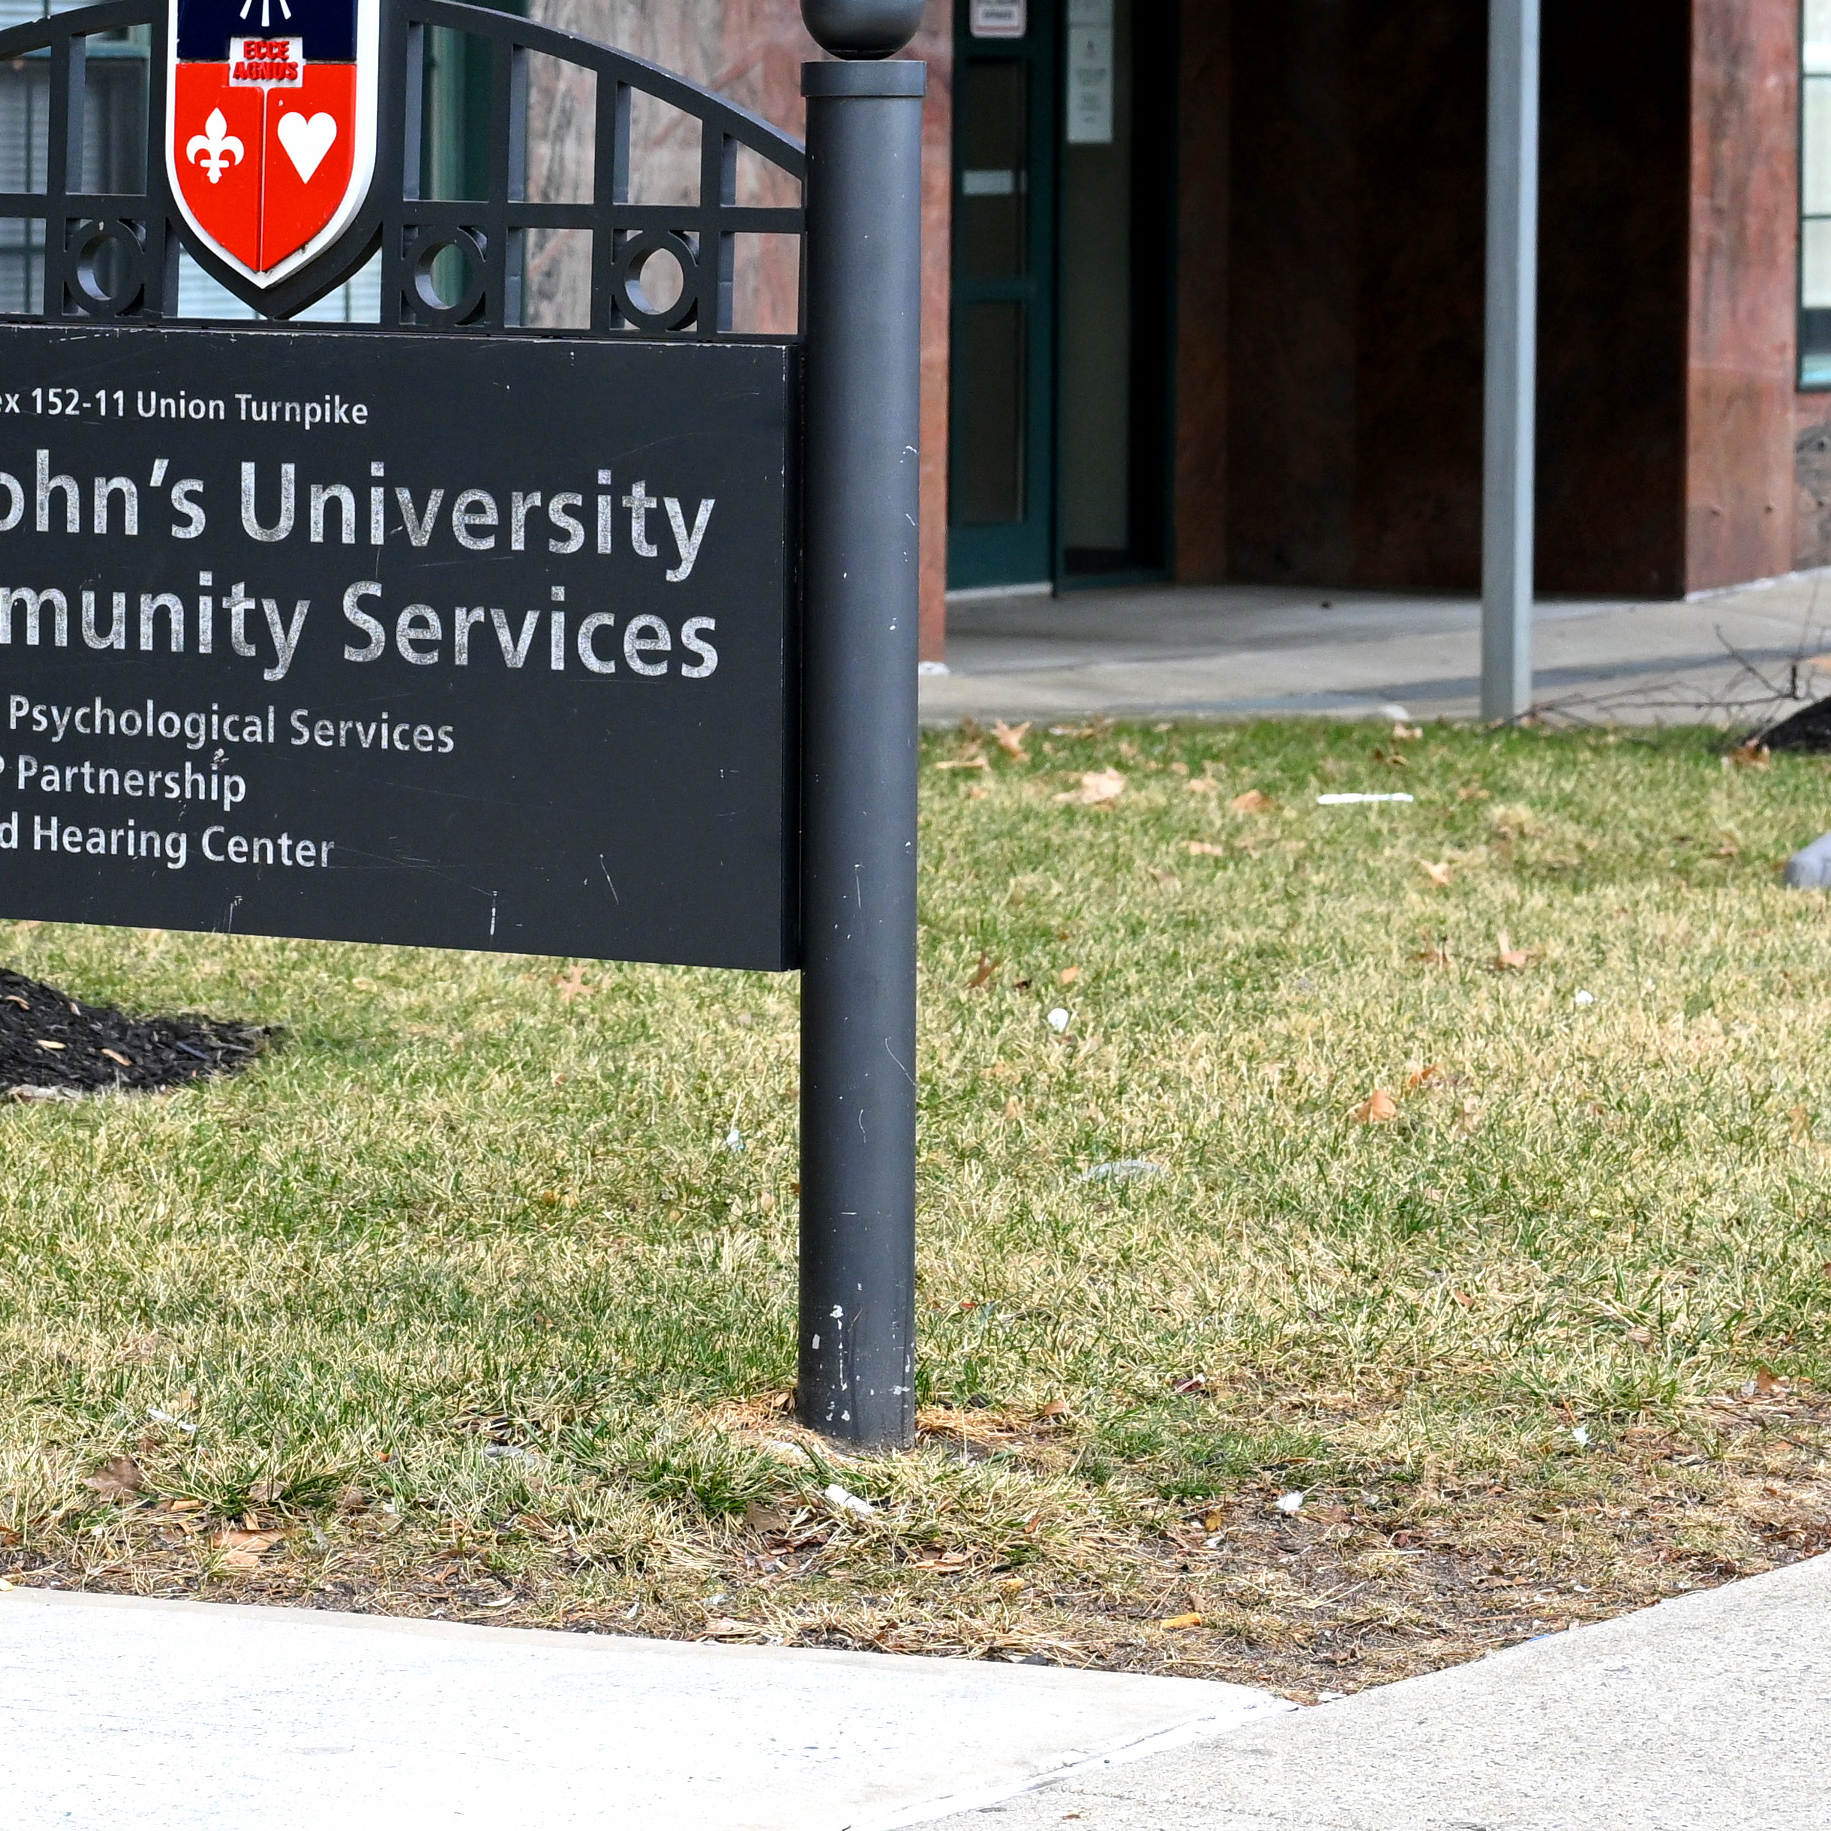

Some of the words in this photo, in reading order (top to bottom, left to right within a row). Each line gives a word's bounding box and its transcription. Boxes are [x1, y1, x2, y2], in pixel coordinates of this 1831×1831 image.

[232, 60, 299, 81] AGNUS
[243, 40, 291, 61] ECCE
[31, 387, 124, 417] 152-11
[137, 390, 225, 420] Union
[234, 393, 369, 431] Turnpike
[240, 461, 716, 583] University
[342, 580, 719, 679] Services
[9, 694, 275, 750] Psychological
[290, 708, 455, 754] Services
[17, 754, 246, 808] Partnership
[33, 814, 187, 870] Hearing
[201, 825, 335, 868] Center
